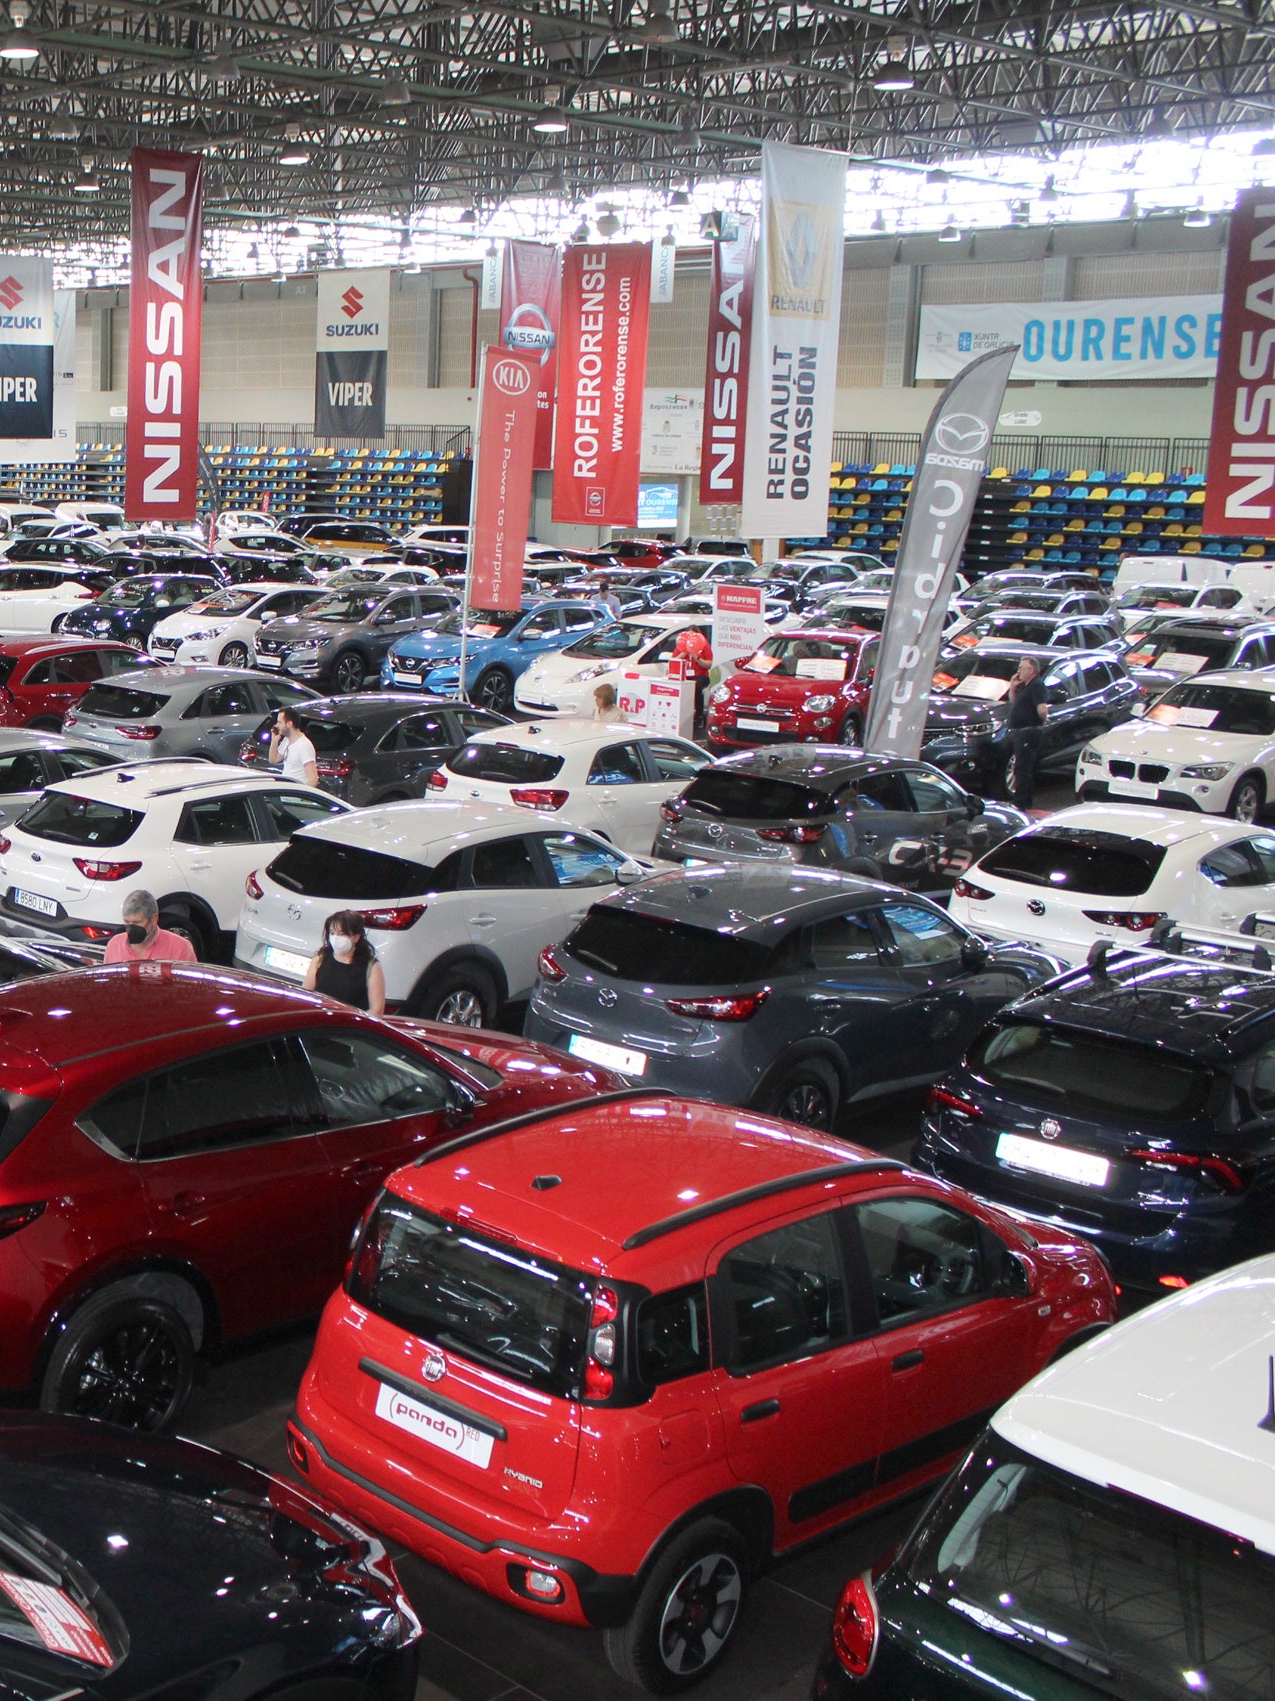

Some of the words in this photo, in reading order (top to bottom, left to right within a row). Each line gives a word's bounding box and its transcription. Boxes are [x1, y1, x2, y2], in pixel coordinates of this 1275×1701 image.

[701, 215, 720, 238] A
[771, 295, 827, 314] RENAULT
[143, 168, 186, 503] NISSAN
[325, 323, 379, 337] SUZUKI
[507, 330, 551, 345] NISSAN
[1024, 313, 1223, 363] OURENSE
[973, 341, 983, 349] DE
[574, 252, 607, 478] ROFERORENSE
[612, 277, 631, 452] www.roferorense.com
[498, 366, 525, 388] KIA
[327, 382, 373, 407] VIPER
[503, 410, 516, 441] The
[766, 345, 793, 500] RENAULT
[791, 346, 818, 501] OCASIÓN
[497, 446, 513, 504] Power
[495, 508, 505, 527] to
[491, 531, 505, 603] Surprise
[726, 595, 757, 605] MAPFRE
[729, 625, 757, 634] VENTAJAS
[20, 892, 37, 908] 8580
[38, 899, 54, 912] LNY
[465, 1427, 481, 1442] RED
[503, 1466, 544, 1489] HYBRID
